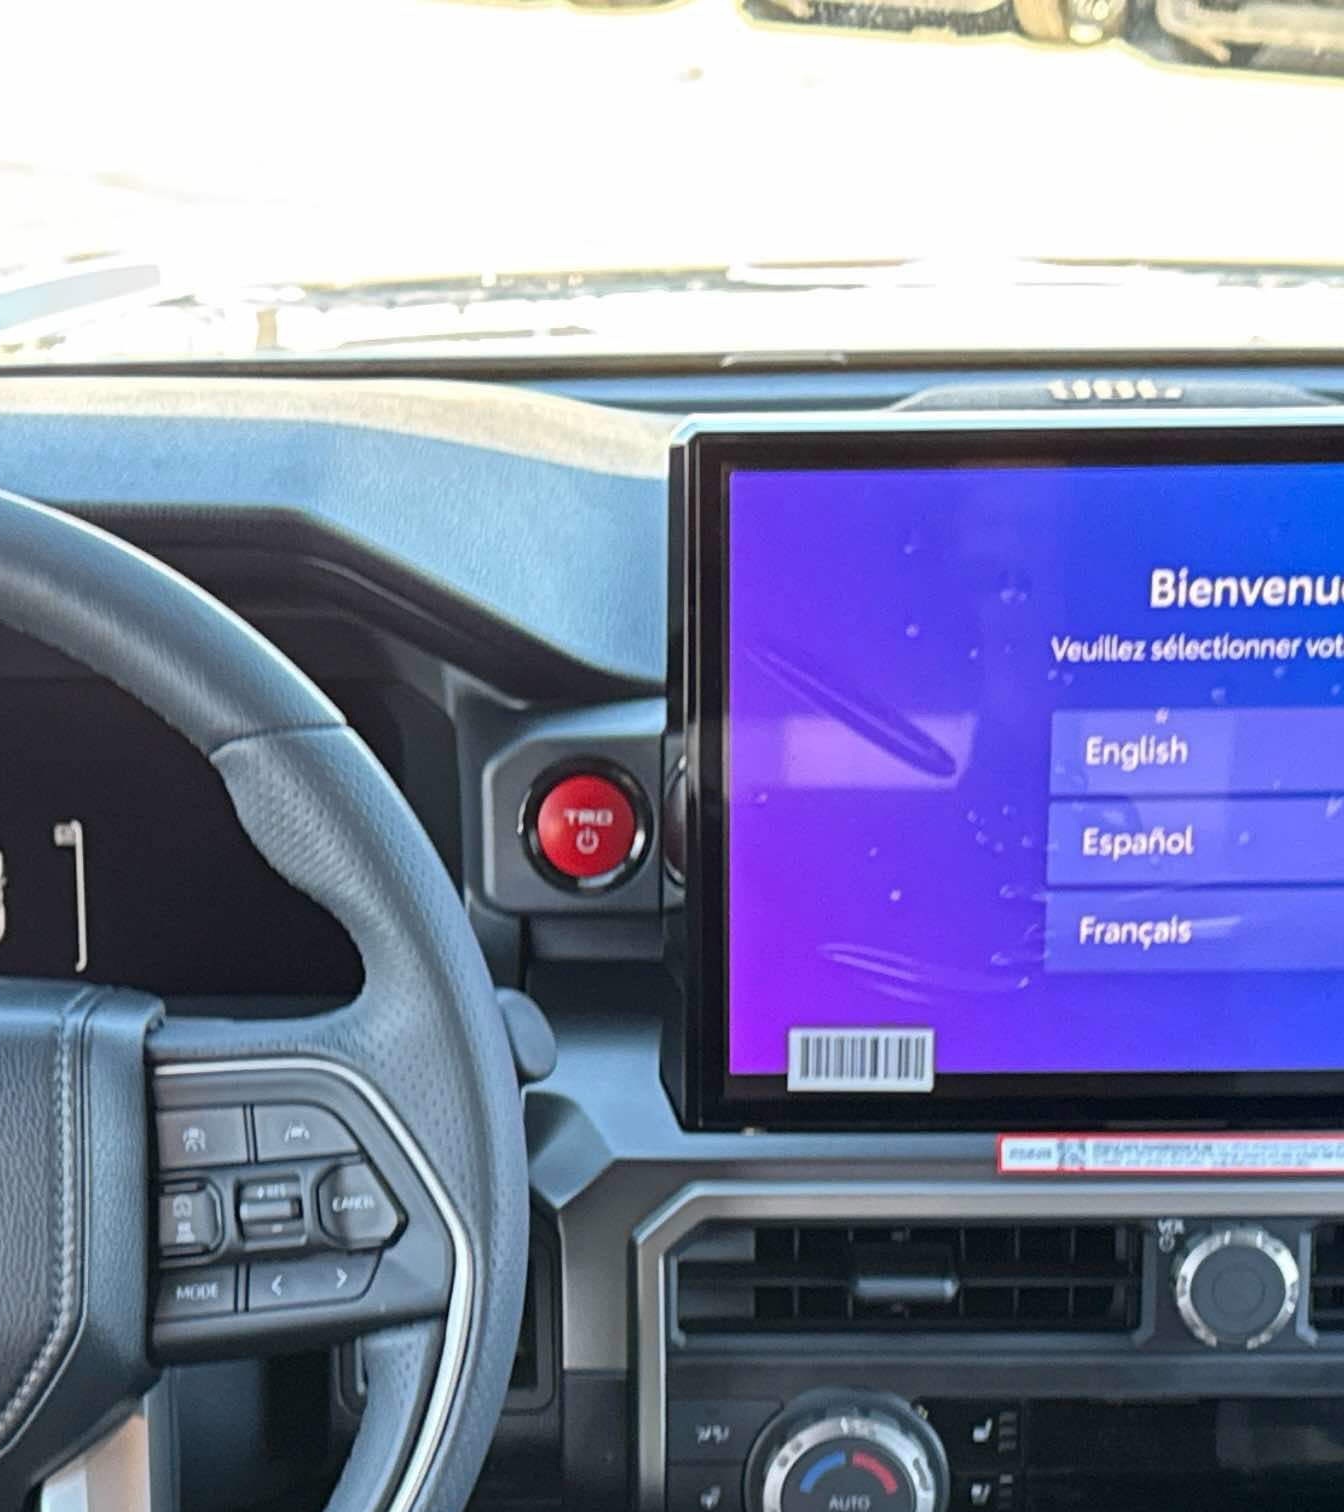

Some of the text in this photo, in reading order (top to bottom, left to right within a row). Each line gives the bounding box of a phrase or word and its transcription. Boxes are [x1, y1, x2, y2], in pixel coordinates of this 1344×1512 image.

[1051, 634, 1146, 663] Veuillez
[1151, 632, 1302, 662] sélectionner
[1085, 735, 1189, 772] English
[1082, 823, 1195, 862] Español
[1079, 914, 1193, 951] Français
[828, 1495, 871, 1512] AUTO
